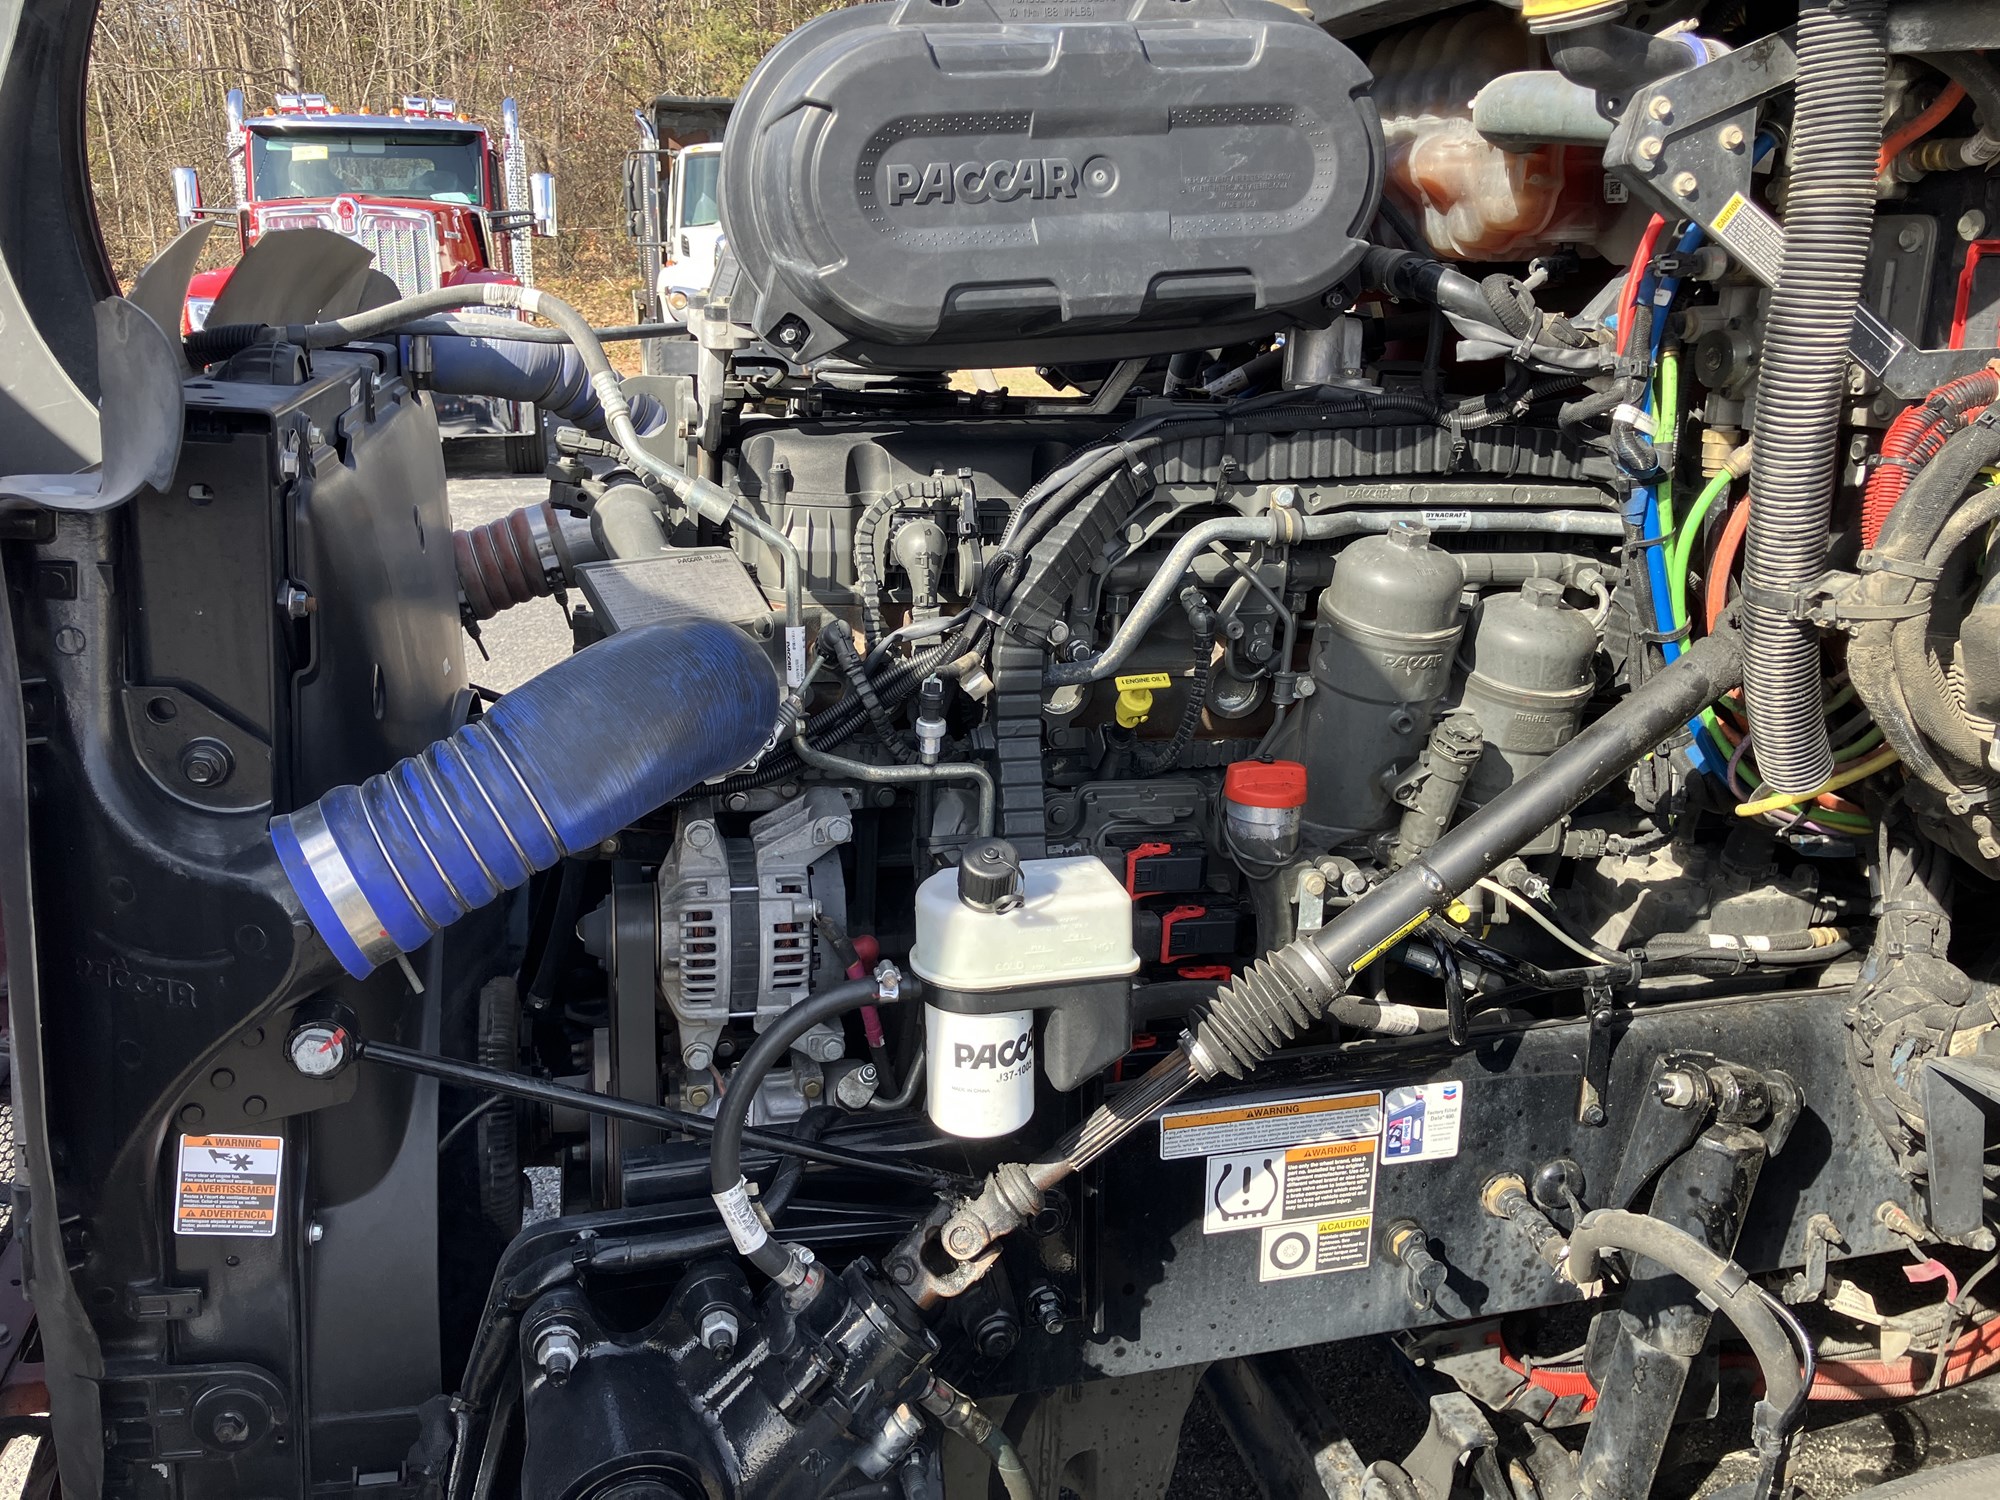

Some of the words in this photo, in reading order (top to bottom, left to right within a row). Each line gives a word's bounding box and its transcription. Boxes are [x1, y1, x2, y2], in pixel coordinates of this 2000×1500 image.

[886, 158, 1077, 206] PACCAR
[1717, 198, 1742, 229] CAUTION
[1741, 206, 1763, 227] Extended
[677, 556, 703, 564] PACCAR
[1515, 712, 1551, 723] MAHLE
[1386, 928, 1408, 946] CAUTION
[995, 961, 1024, 971] COLD
[1254, 1105, 1299, 1117] WARNING
[215, 1139, 262, 1147] WARNING
[1312, 1144, 1356, 1157] WARNING
[1346, 1162, 1364, 1170] original
[1287, 1174, 1313, 1182] equipment
[1314, 1170, 1348, 1178] manufacturer.
[196, 1184, 273, 1194] AVERTISSEMENT
[1305, 1188, 1333, 1197] component
[1314, 1200, 1336, 1208] personal
[200, 1209, 267, 1219] ADVERTENCIA
[1327, 1219, 1368, 1230] CAUTION
